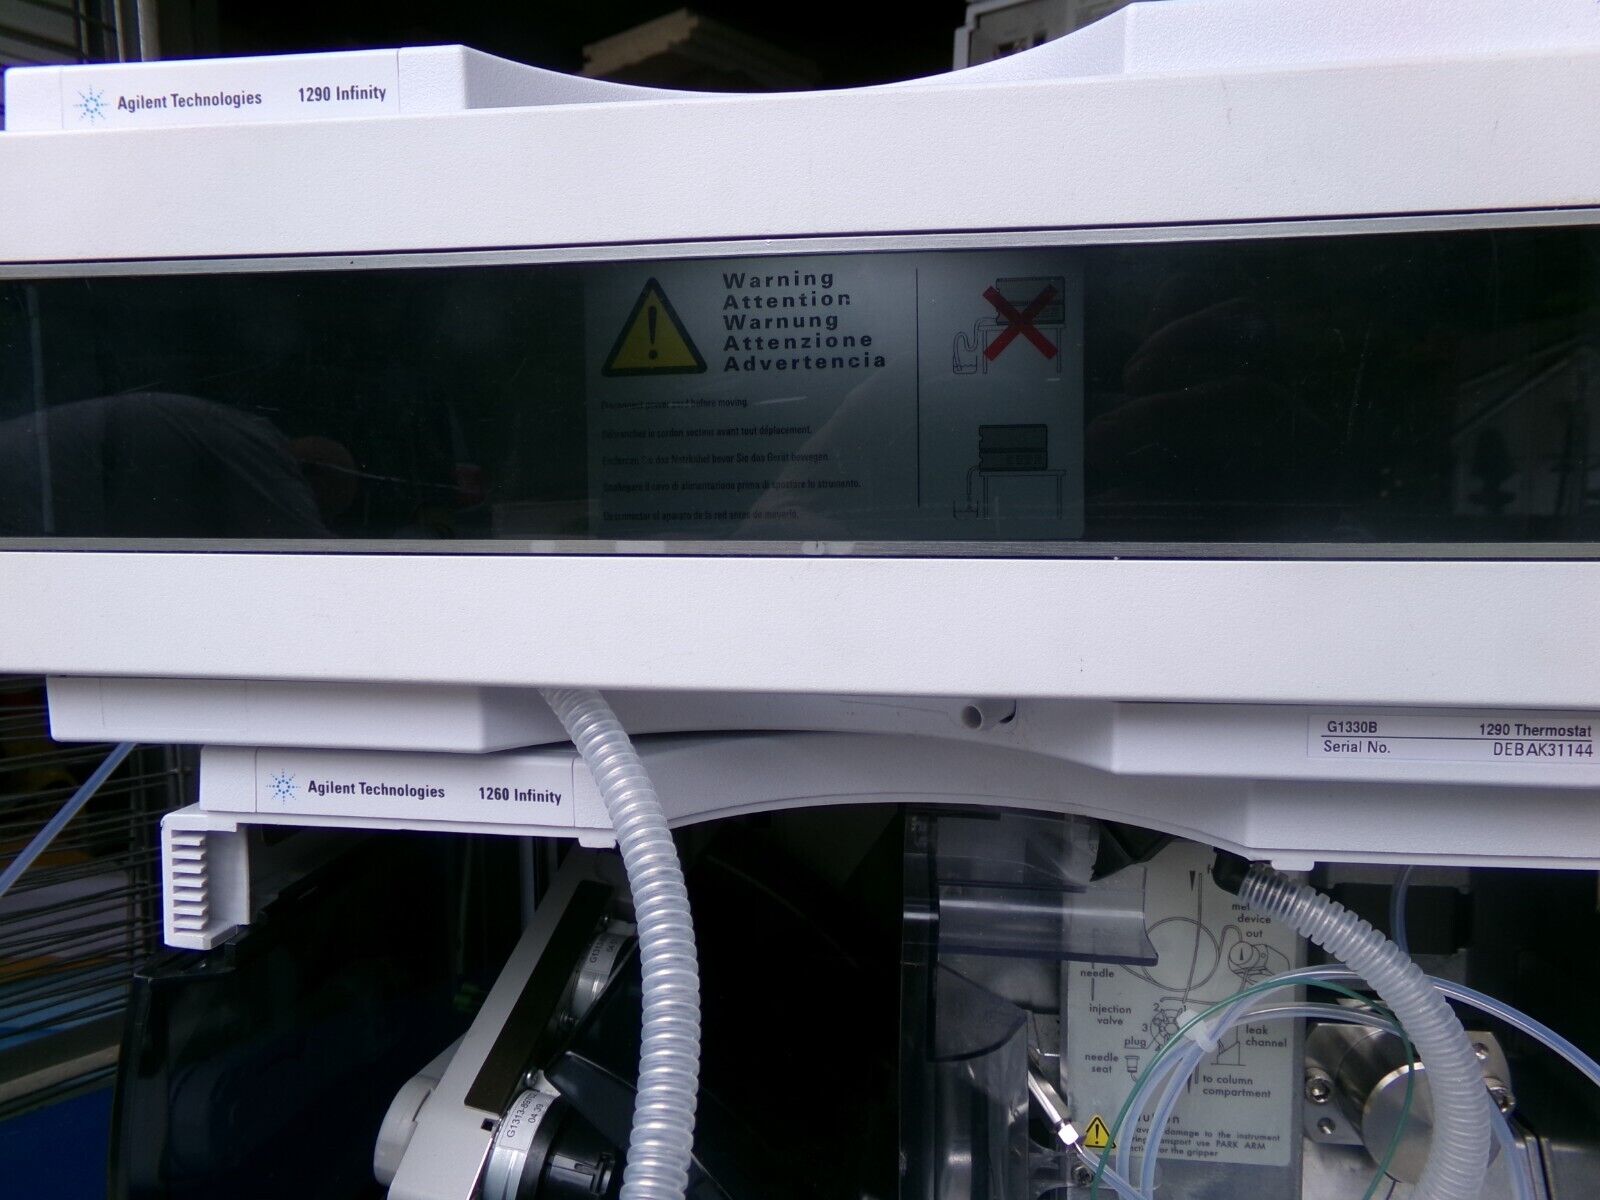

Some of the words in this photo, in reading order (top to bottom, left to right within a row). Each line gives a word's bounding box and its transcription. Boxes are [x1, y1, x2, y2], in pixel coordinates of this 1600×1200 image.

[298, 86, 331, 102] 1290
[335, 85, 387, 102] Infinity
[117, 94, 168, 113] Agilent
[170, 91, 262, 109] Technologies
[723, 270, 834, 289] Warning
[723, 291, 851, 310] Attention
[723, 313, 839, 331] Warnung
[723, 333, 872, 351] Attenzione
[723, 352, 886, 372] Advertencia
[1327, 720, 1378, 734] G1330B
[1479, 723, 1511, 736] 1290
[1514, 723, 1592, 738] Thermostat
[1323, 740, 1362, 753] Serial
[1367, 741, 1391, 754] No.
[1493, 742, 1594, 757] DEBAK31144
[307, 780, 356, 797] Agilent
[359, 781, 446, 800] Technologies
[478, 787, 509, 801] 1260
[514, 788, 562, 806] Infinity
[1237, 913, 1272, 924] device
[1245, 930, 1263, 938] out
[1080, 968, 1115, 979] needle
[1089, 1003, 1132, 1016] injection
[1153, 1002, 1161, 1012] 2
[1097, 1016, 1124, 1026] valve
[1142, 1022, 1149, 1033] 3
[1245, 1025, 1269, 1035] leak
[1124, 1036, 1147, 1049] plug
[1245, 1038, 1287, 1049] channel
[1085, 1052, 1119, 1063] needle
[1091, 1064, 1113, 1074] seat
[1203, 1074, 1214, 1084] to
[1216, 1075, 1254, 1086] column
[1202, 1087, 1272, 1099] compartment
[1165, 1128, 1200, 1138] damage
[1218, 1131, 1231, 1139] the
[1236, 1132, 1281, 1142] instrument
[1215, 1140, 1239, 1149] PARK
[1244, 1142, 1266, 1150] ARM
[1171, 1147, 1184, 1155] the
[1186, 1150, 1218, 1158] gripper
